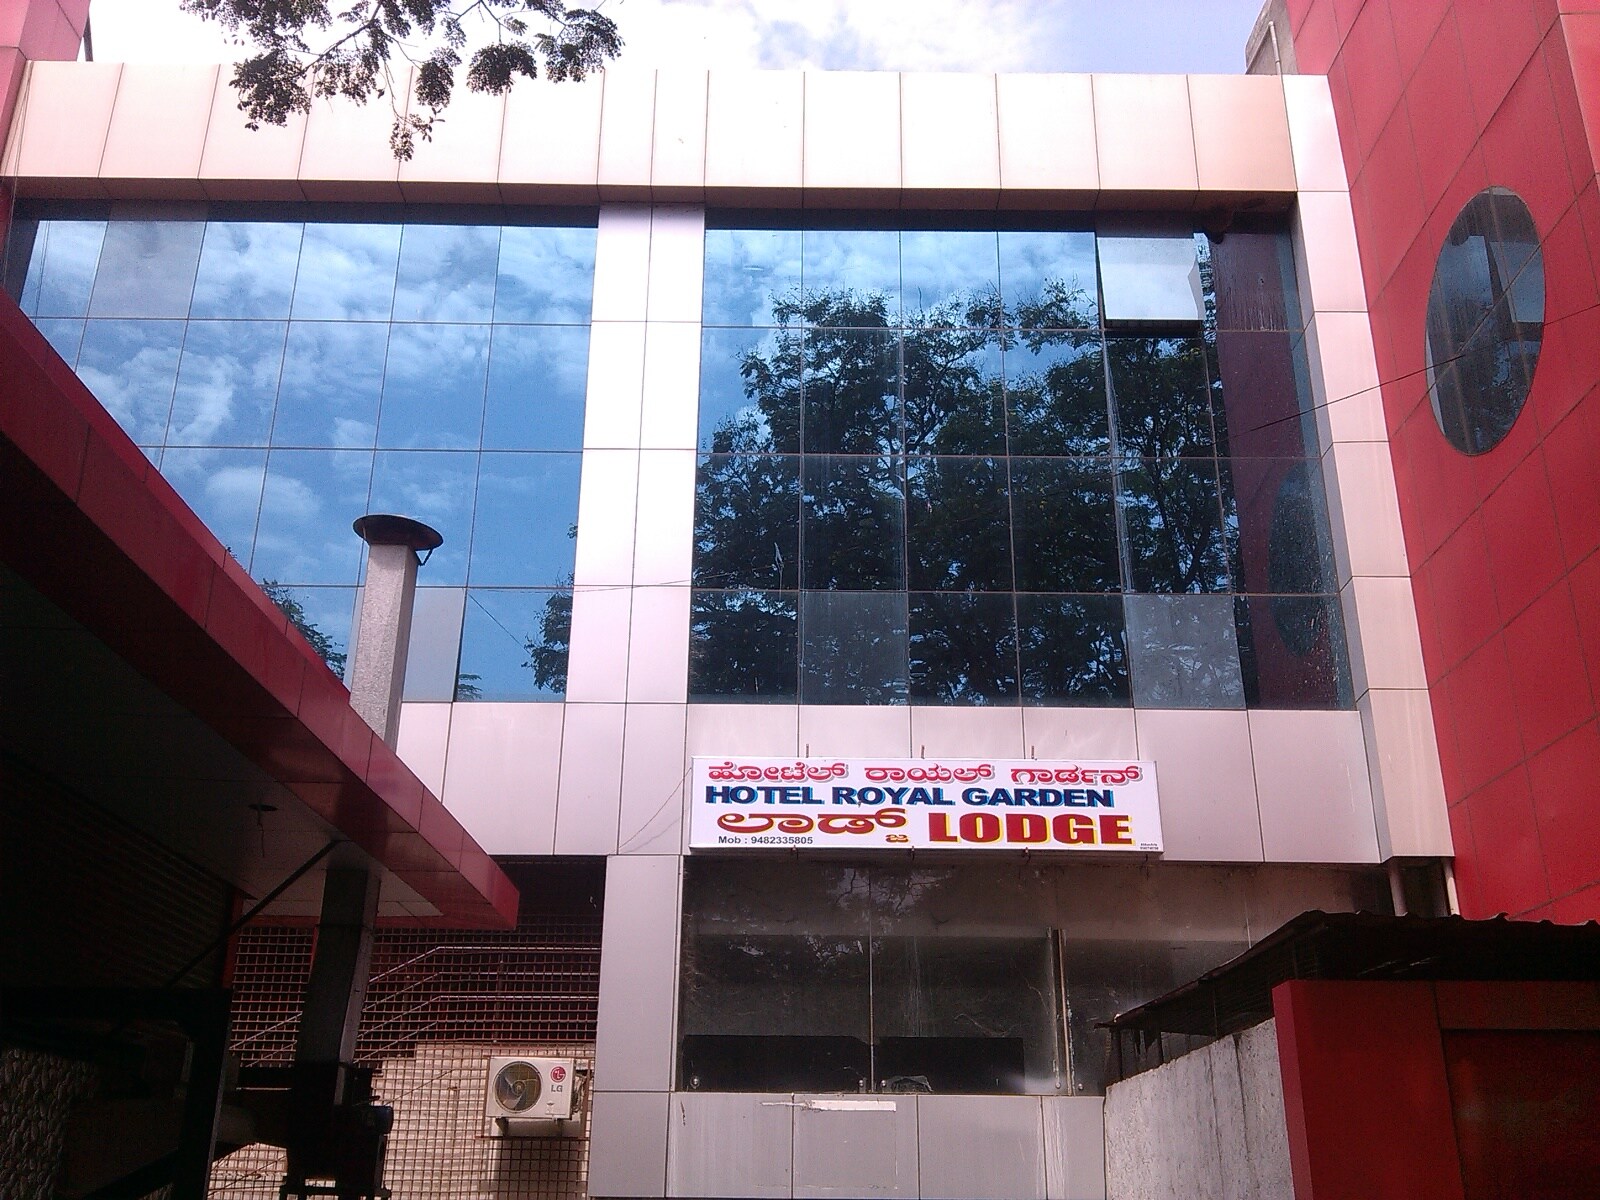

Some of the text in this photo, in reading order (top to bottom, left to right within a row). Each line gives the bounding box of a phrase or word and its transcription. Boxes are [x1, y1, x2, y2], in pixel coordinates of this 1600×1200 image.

[708, 761, 848, 782] ಹೋಟೆಲ್
[864, 763, 994, 783] ರಾಯಲ್
[705, 785, 1114, 807] HOTEL ROYAL GARDEN
[928, 812, 1135, 845] LODGE
[751, 836, 813, 844] 9482335805
